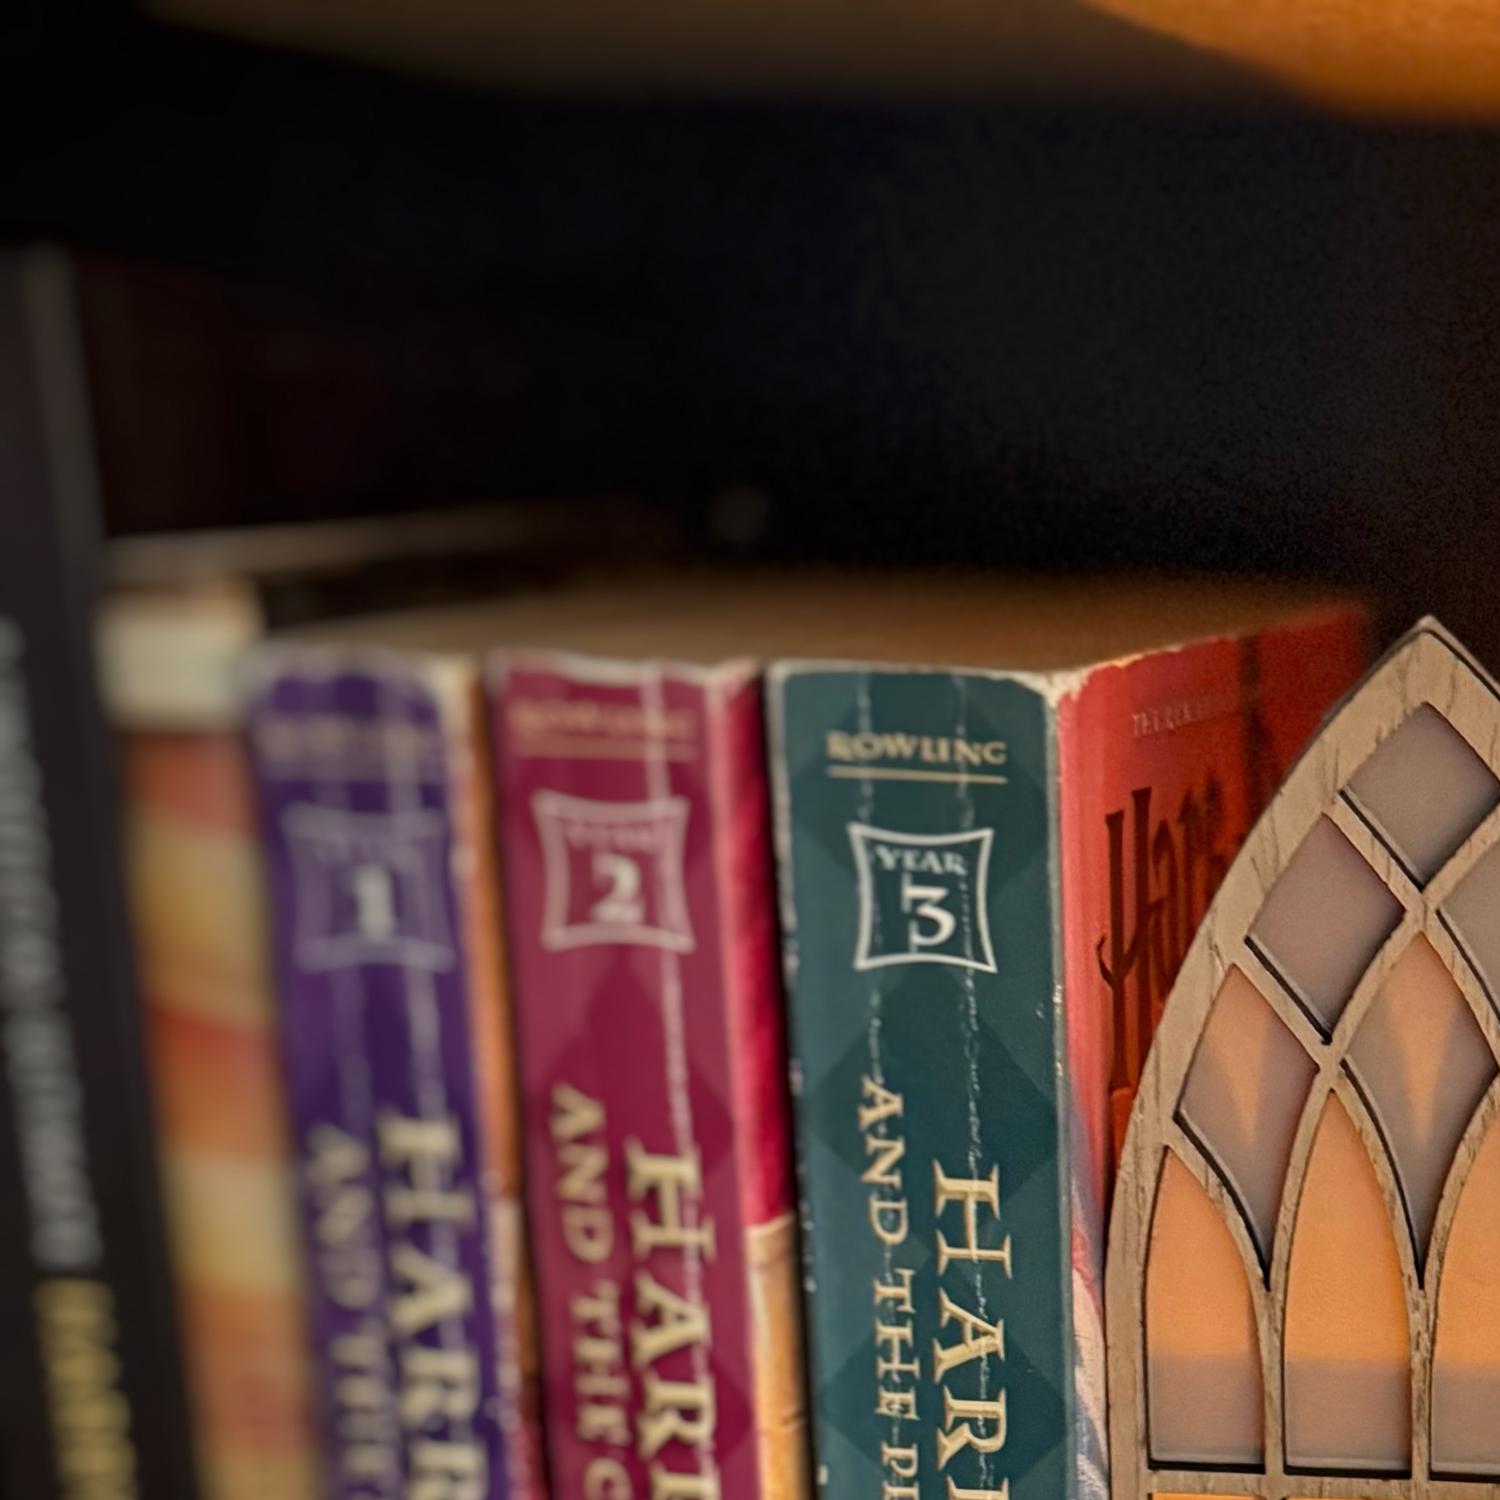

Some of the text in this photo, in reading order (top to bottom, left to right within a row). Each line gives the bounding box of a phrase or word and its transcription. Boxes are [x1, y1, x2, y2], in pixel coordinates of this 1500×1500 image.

[825, 730, 1008, 766] ROWLING
[592, 853, 642, 925] 2
[873, 845, 968, 875] YEAR
[902, 885, 955, 946] 3
[551, 1083, 615, 1262] AND
[857, 1076, 909, 1245] AND
[572, 1280, 632, 1444] THE
[873, 1268, 921, 1421] THE
